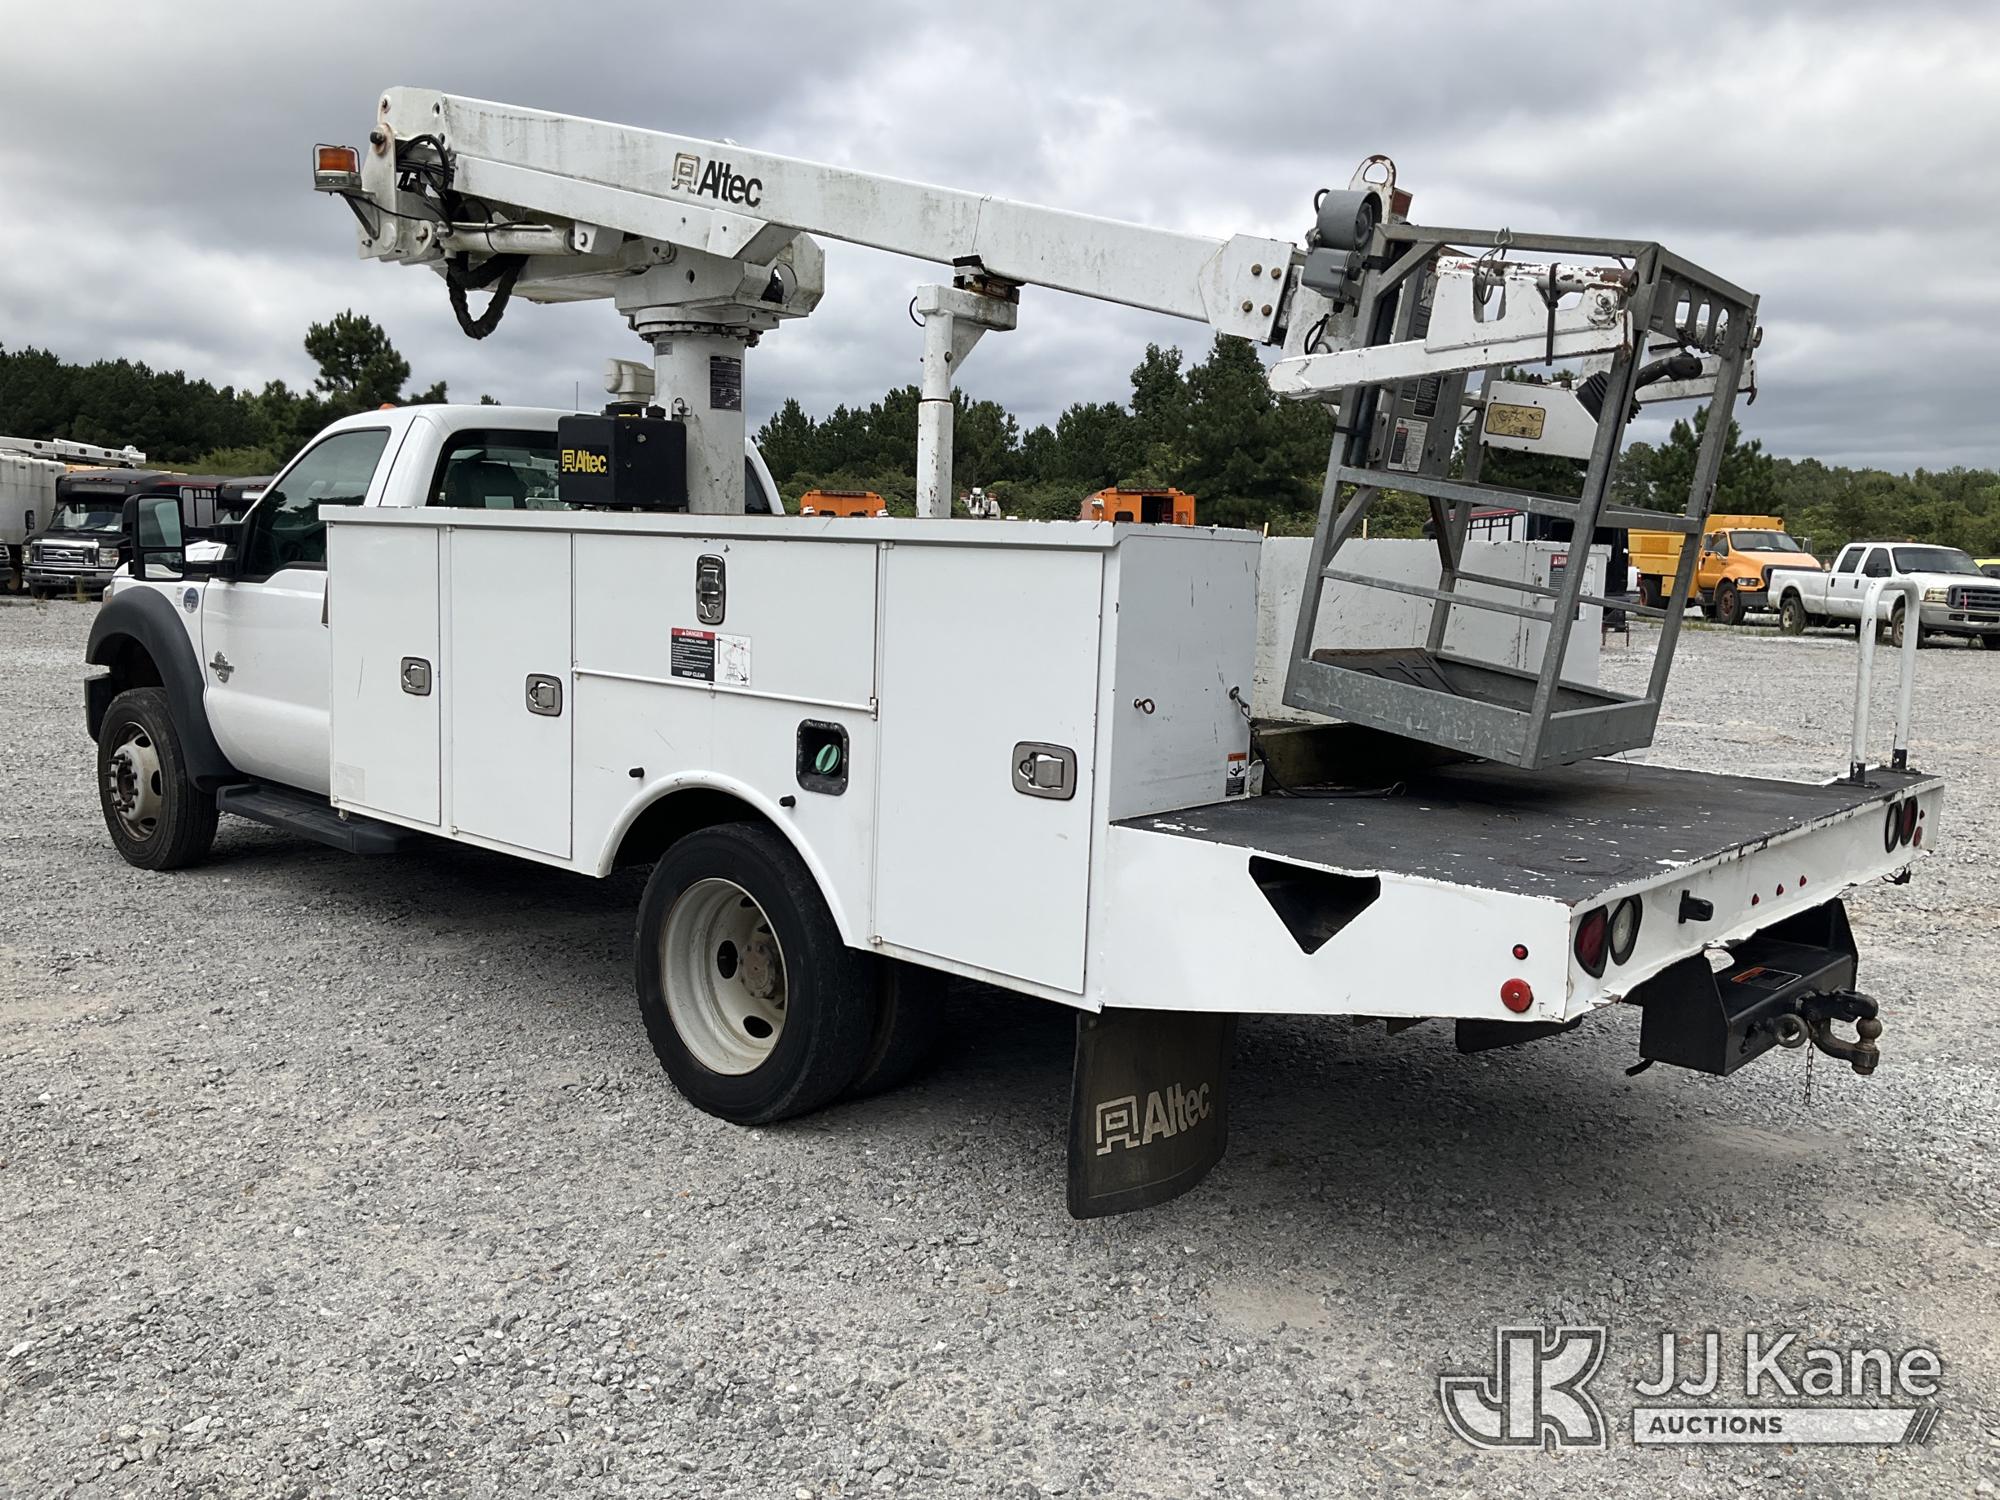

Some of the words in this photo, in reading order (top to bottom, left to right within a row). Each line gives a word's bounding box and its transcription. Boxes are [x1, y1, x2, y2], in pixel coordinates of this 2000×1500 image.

[697, 160, 763, 208] Altec
[575, 450, 607, 473] Altec
[685, 630, 704, 638] DANGER
[1142, 1082, 1210, 1145] Altec
